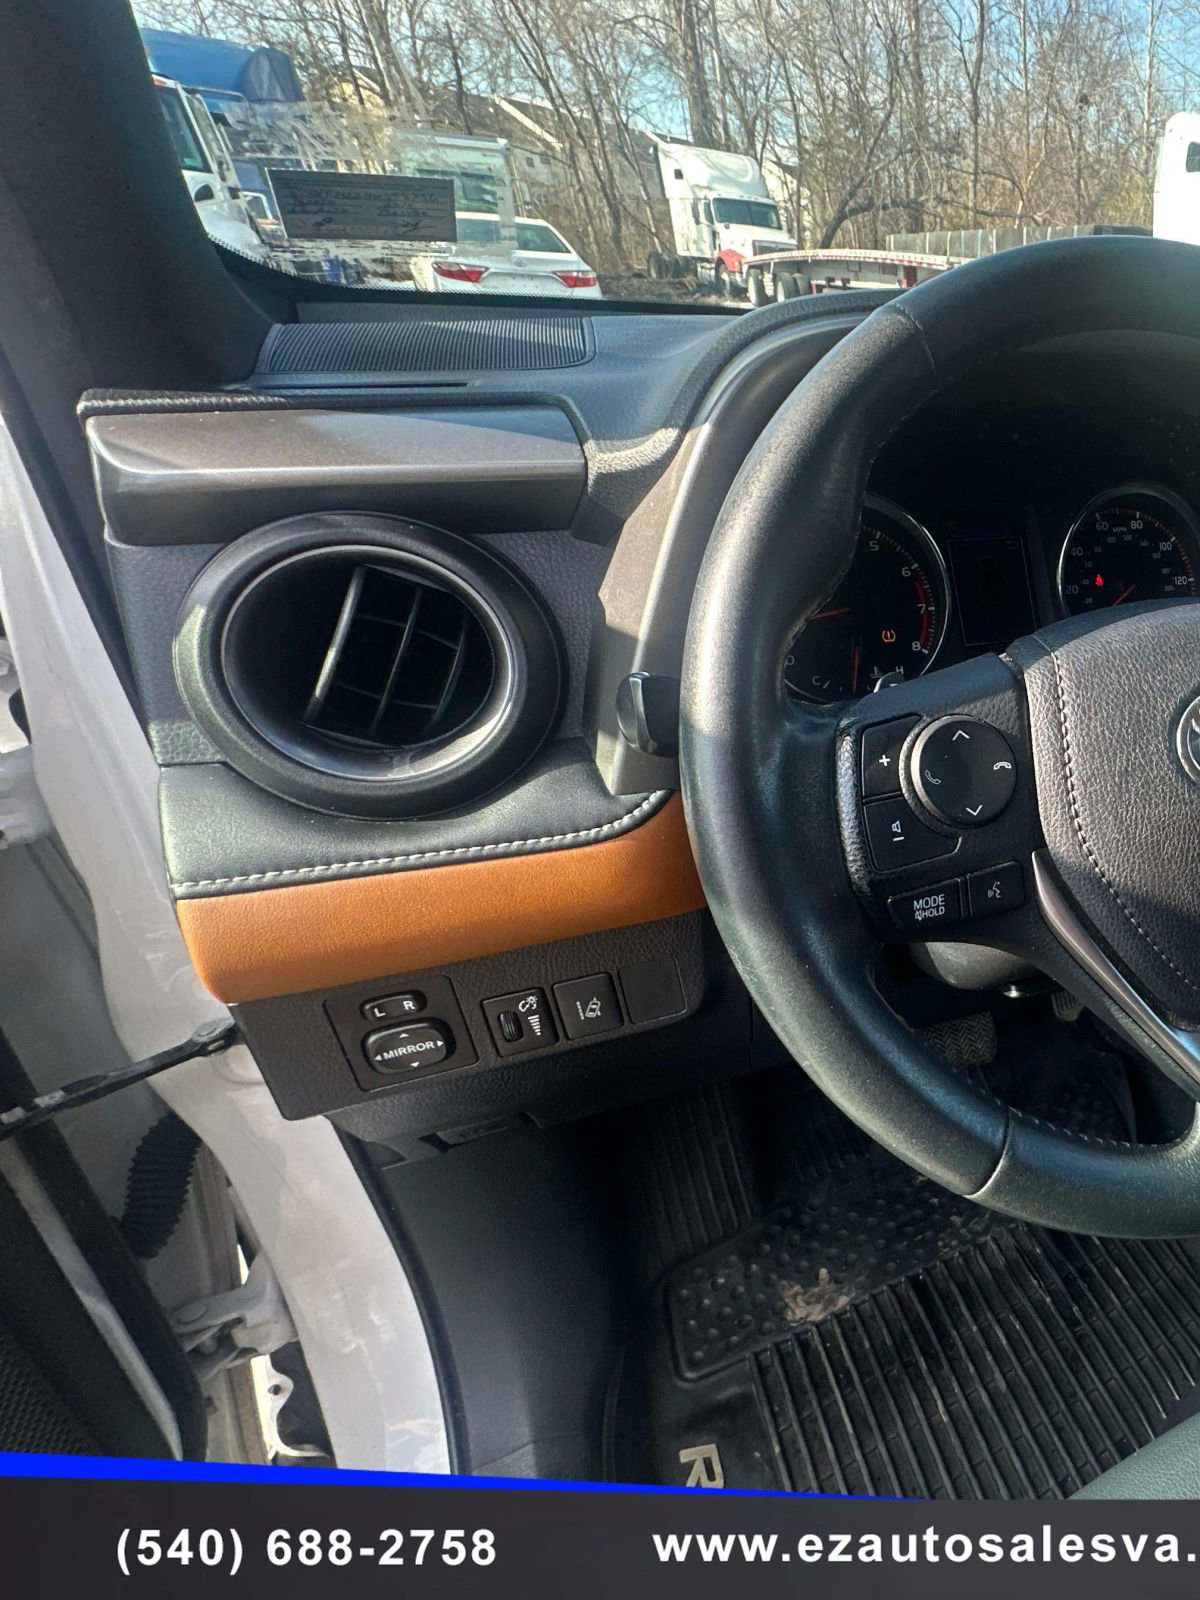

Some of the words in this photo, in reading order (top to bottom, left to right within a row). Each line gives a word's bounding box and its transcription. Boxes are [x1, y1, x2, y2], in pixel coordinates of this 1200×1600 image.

[1130, 520, 1143, 530] 80
[869, 540, 879, 551] 5
[1159, 541, 1172, 551] 100
[902, 567, 911, 577] 6
[1174, 575, 1188, 585] 120
[917, 603, 926, 614] 7
[912, 641, 921, 651] 8
[913, 893, 945, 910] MODE
[922, 906, 945, 919] HOLD
[403, 1000, 415, 1011] R
[374, 1007, 386, 1018] L
[383, 1040, 436, 1061] MIRROR
